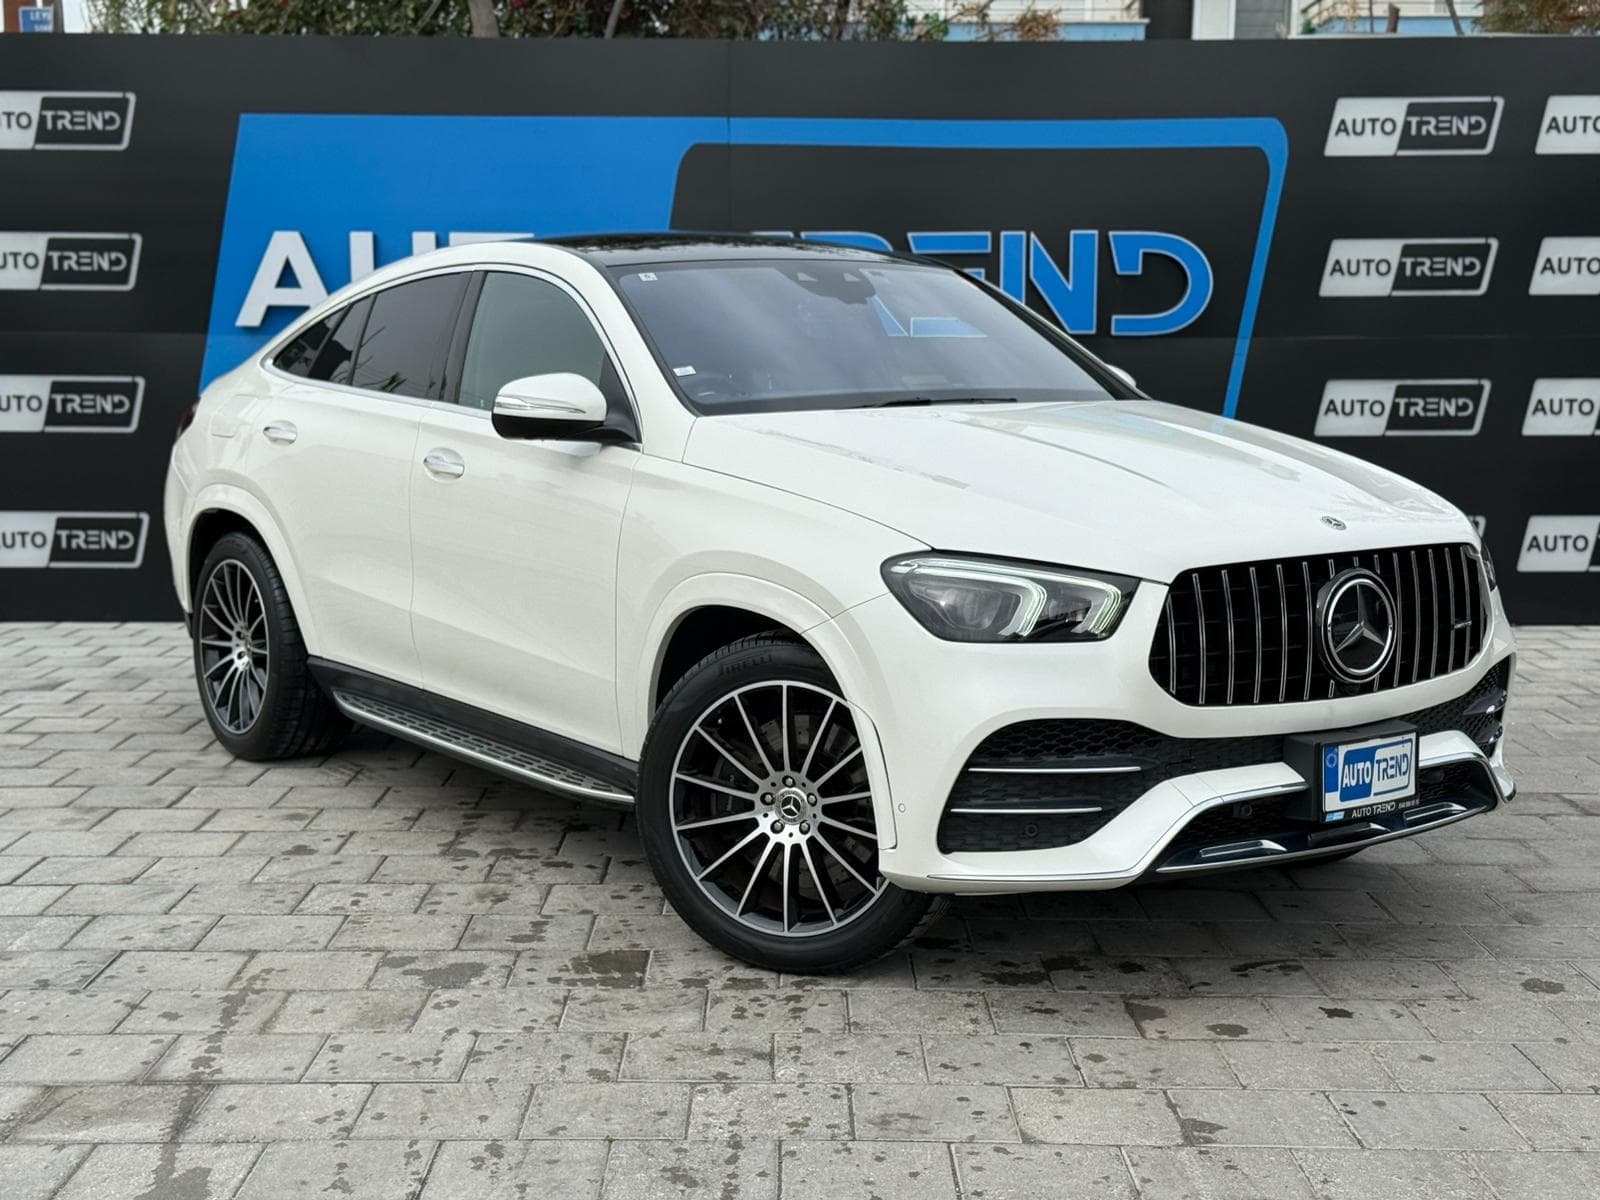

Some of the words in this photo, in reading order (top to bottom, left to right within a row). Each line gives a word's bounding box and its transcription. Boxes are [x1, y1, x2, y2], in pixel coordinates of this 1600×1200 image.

[0, 111, 33, 130] TO
[41, 110, 121, 131] TREND
[1334, 117, 1397, 136] AUTO
[1406, 116, 1487, 136] TREND
[0, 251, 40, 270] UTO
[48, 251, 127, 271] TREND
[1329, 258, 1392, 277] AUTO
[1401, 257, 1481, 277] TREND
[1540, 256, 1600, 275] AUTO
[0, 394, 43, 413] UTO
[51, 394, 131, 414] TREND
[1323, 398, 1386, 417] AUTO
[1394, 397, 1474, 417] TREND
[1531, 397, 1595, 416] AUTO
[0, 530, 47, 550] UTO
[56, 529, 135, 550] TREND
[1526, 534, 1590, 553] AUTO
[1342, 761, 1372, 788] AUTO
[1376, 754, 1409, 781] TREND
[1352, 807, 1371, 818] AUTO
[1373, 802, 1395, 814] TREND
